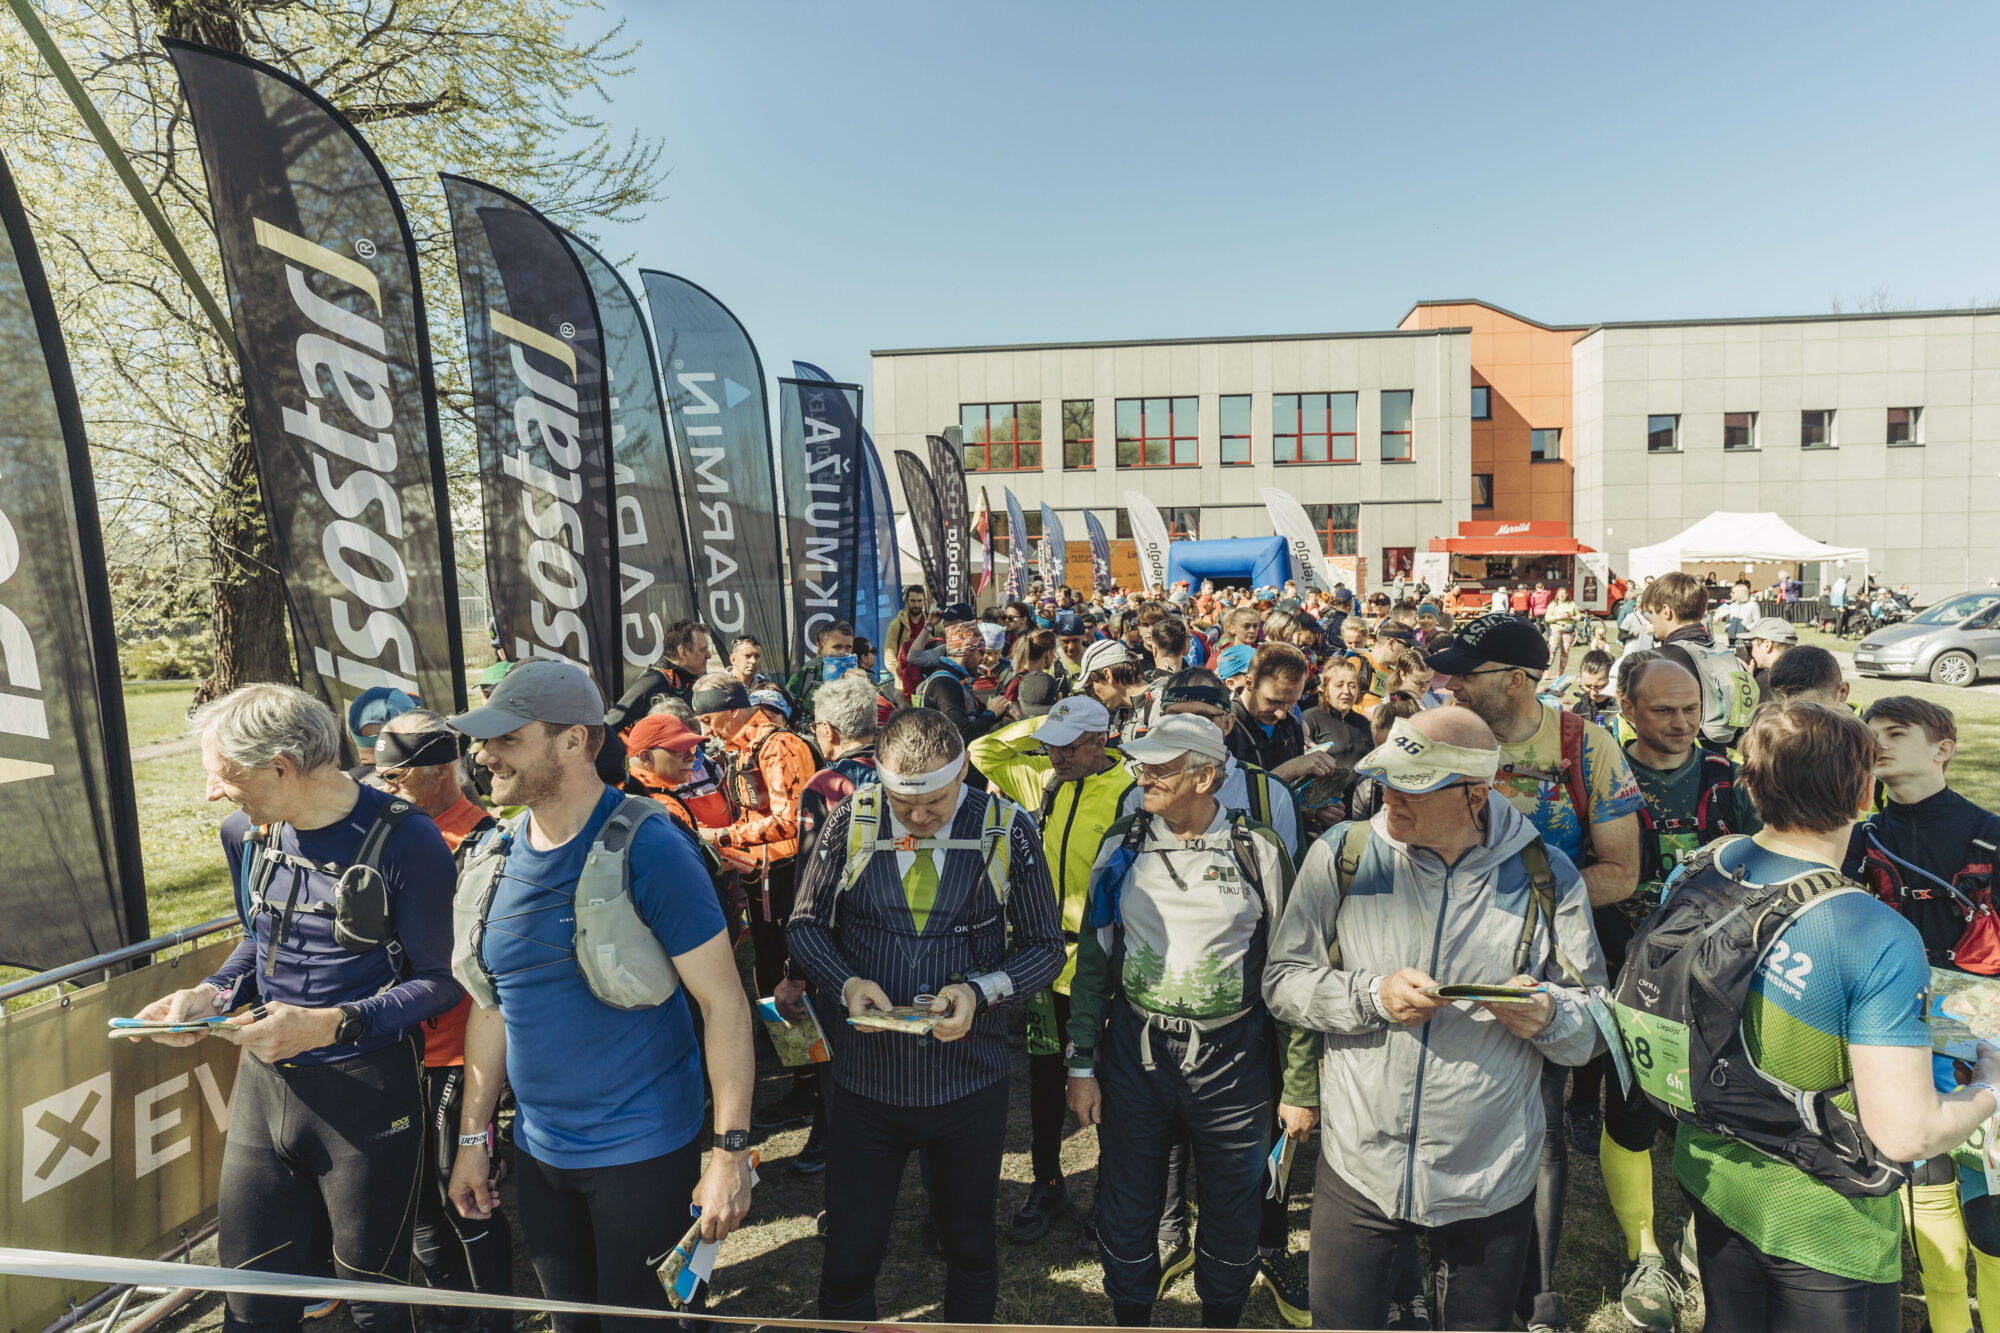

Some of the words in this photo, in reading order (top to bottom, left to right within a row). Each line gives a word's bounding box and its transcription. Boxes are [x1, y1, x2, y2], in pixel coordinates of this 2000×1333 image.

[283, 264, 420, 697] isostar
[503, 343, 590, 673] isostar
[1495, 522, 1530, 536] Merrild
[1462, 613, 1518, 645] ASICS
[1738, 673, 1753, 708] 709
[1394, 736, 1425, 755] 46
[821, 802, 851, 847] MACHIN
[1218, 885, 1251, 896] TUKUS
[1028, 1011, 1045, 1051] 738
[1666, 1073, 1684, 1092] 6h
[135, 1062, 240, 1179] EV
